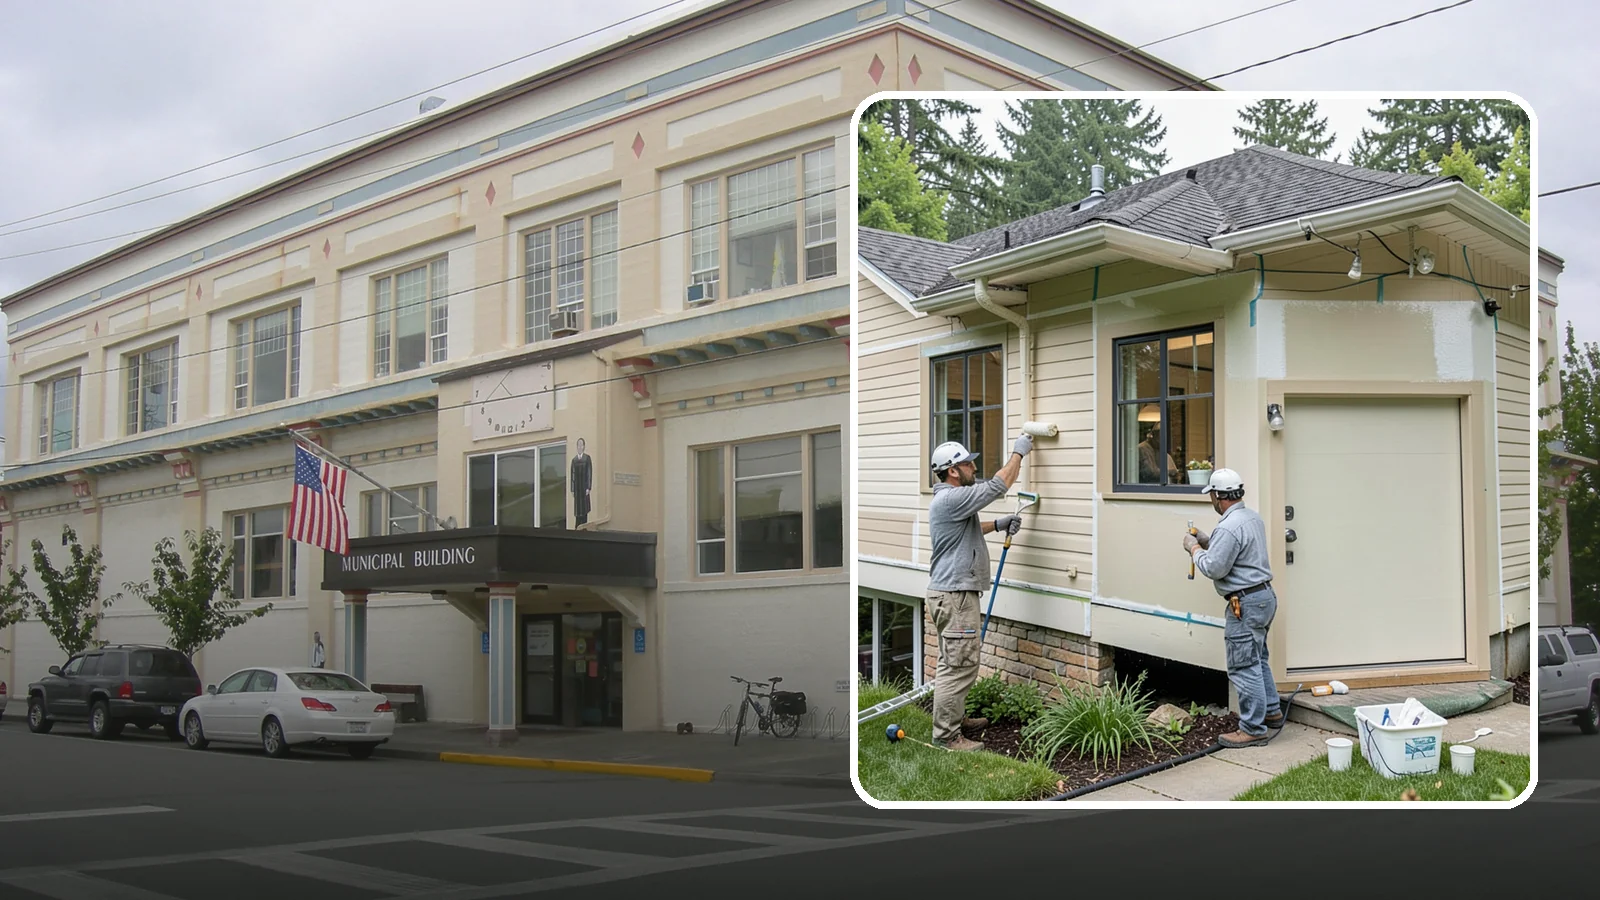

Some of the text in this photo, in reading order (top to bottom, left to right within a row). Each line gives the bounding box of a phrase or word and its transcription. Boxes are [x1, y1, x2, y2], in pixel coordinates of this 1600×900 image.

[546, 361, 551, 370] 6
[475, 390, 479, 398] 7
[536, 402, 540, 410] 4
[480, 407, 485, 415] 8
[487, 417, 492, 425] 9
[528, 414, 533, 422] 3
[494, 423, 500, 432] 10
[501, 425, 506, 433] 11
[507, 425, 513, 433] 12
[521, 420, 525, 428] 2
[342, 546, 475, 572] MUNICIPAL BUILDING
